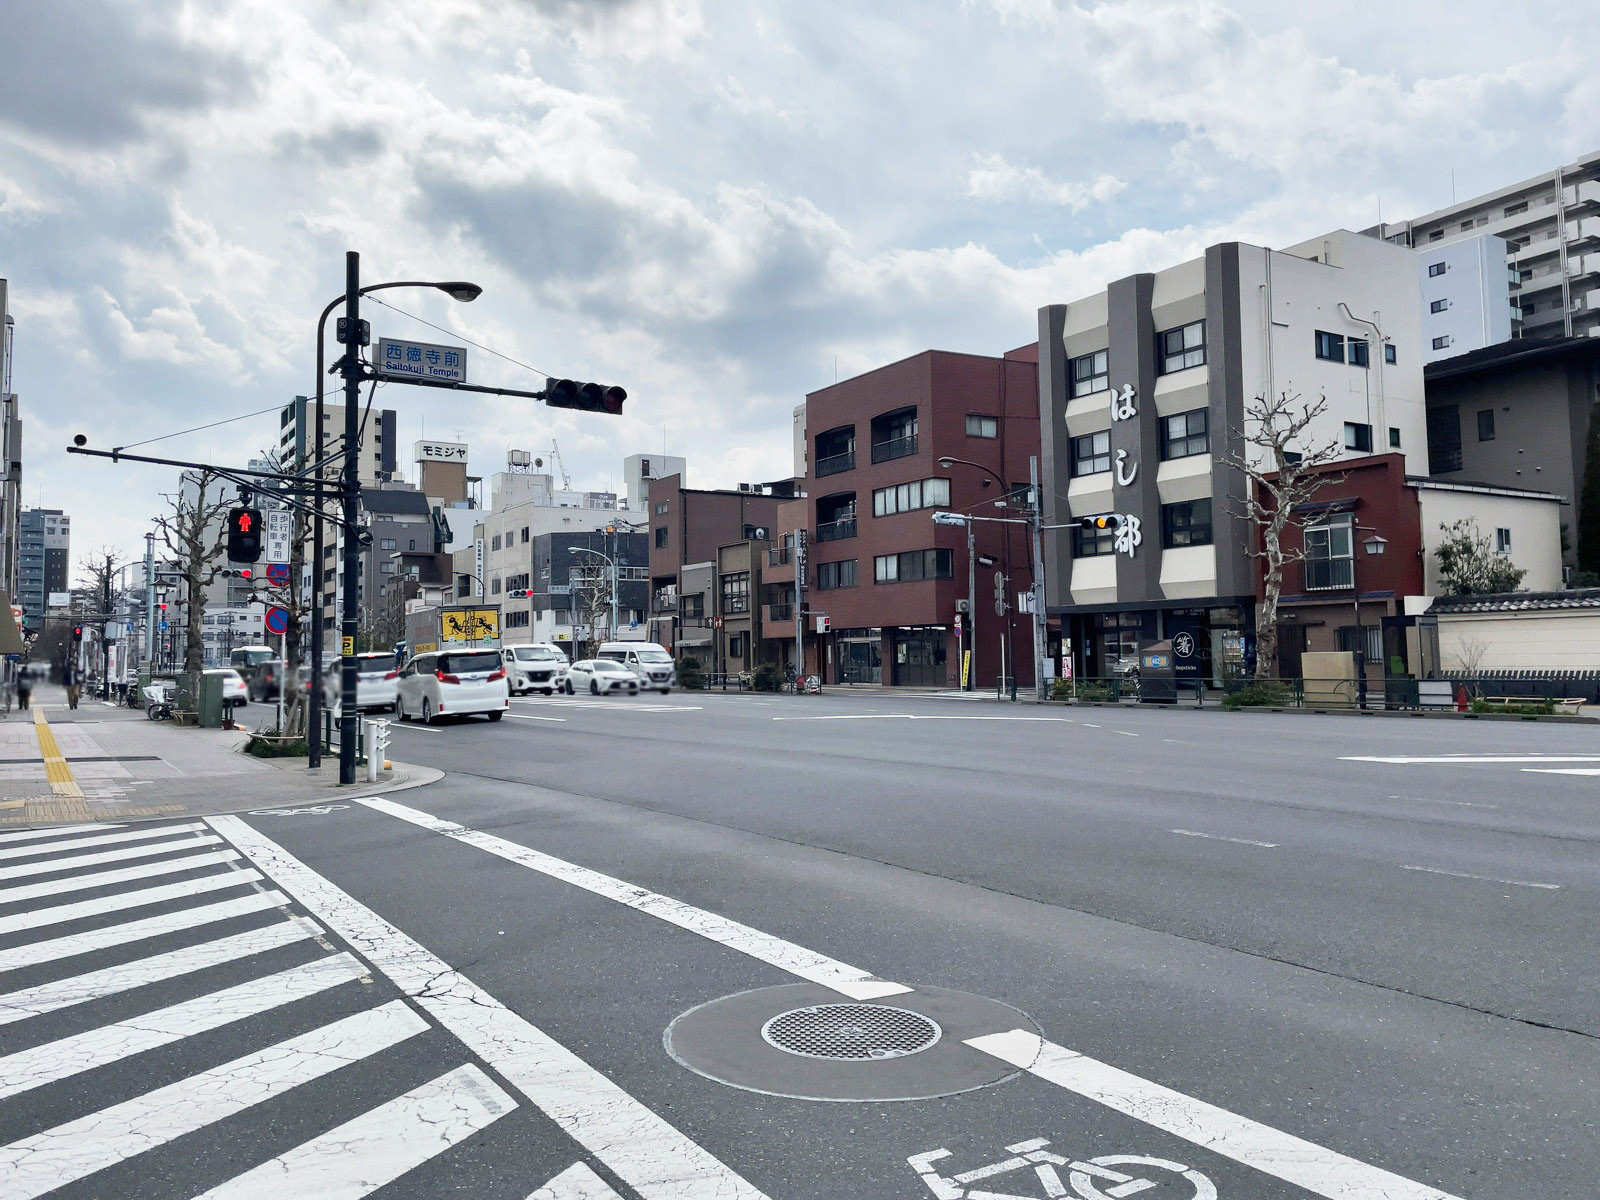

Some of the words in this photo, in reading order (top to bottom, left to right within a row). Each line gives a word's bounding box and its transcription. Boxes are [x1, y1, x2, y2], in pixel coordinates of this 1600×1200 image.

[386, 344, 460, 367] 西徳寺前
[385, 360, 425, 375] Saitokuji
[428, 366, 459, 378] Temple
[422, 445, 466, 459] モミジヤ
[1110, 383, 1142, 559] はし都
[269, 514, 278, 541] 自転車
[279, 514, 289, 541] 歩行者
[273, 541, 282, 559] 専用
[1176, 635, 1191, 654] 箸
